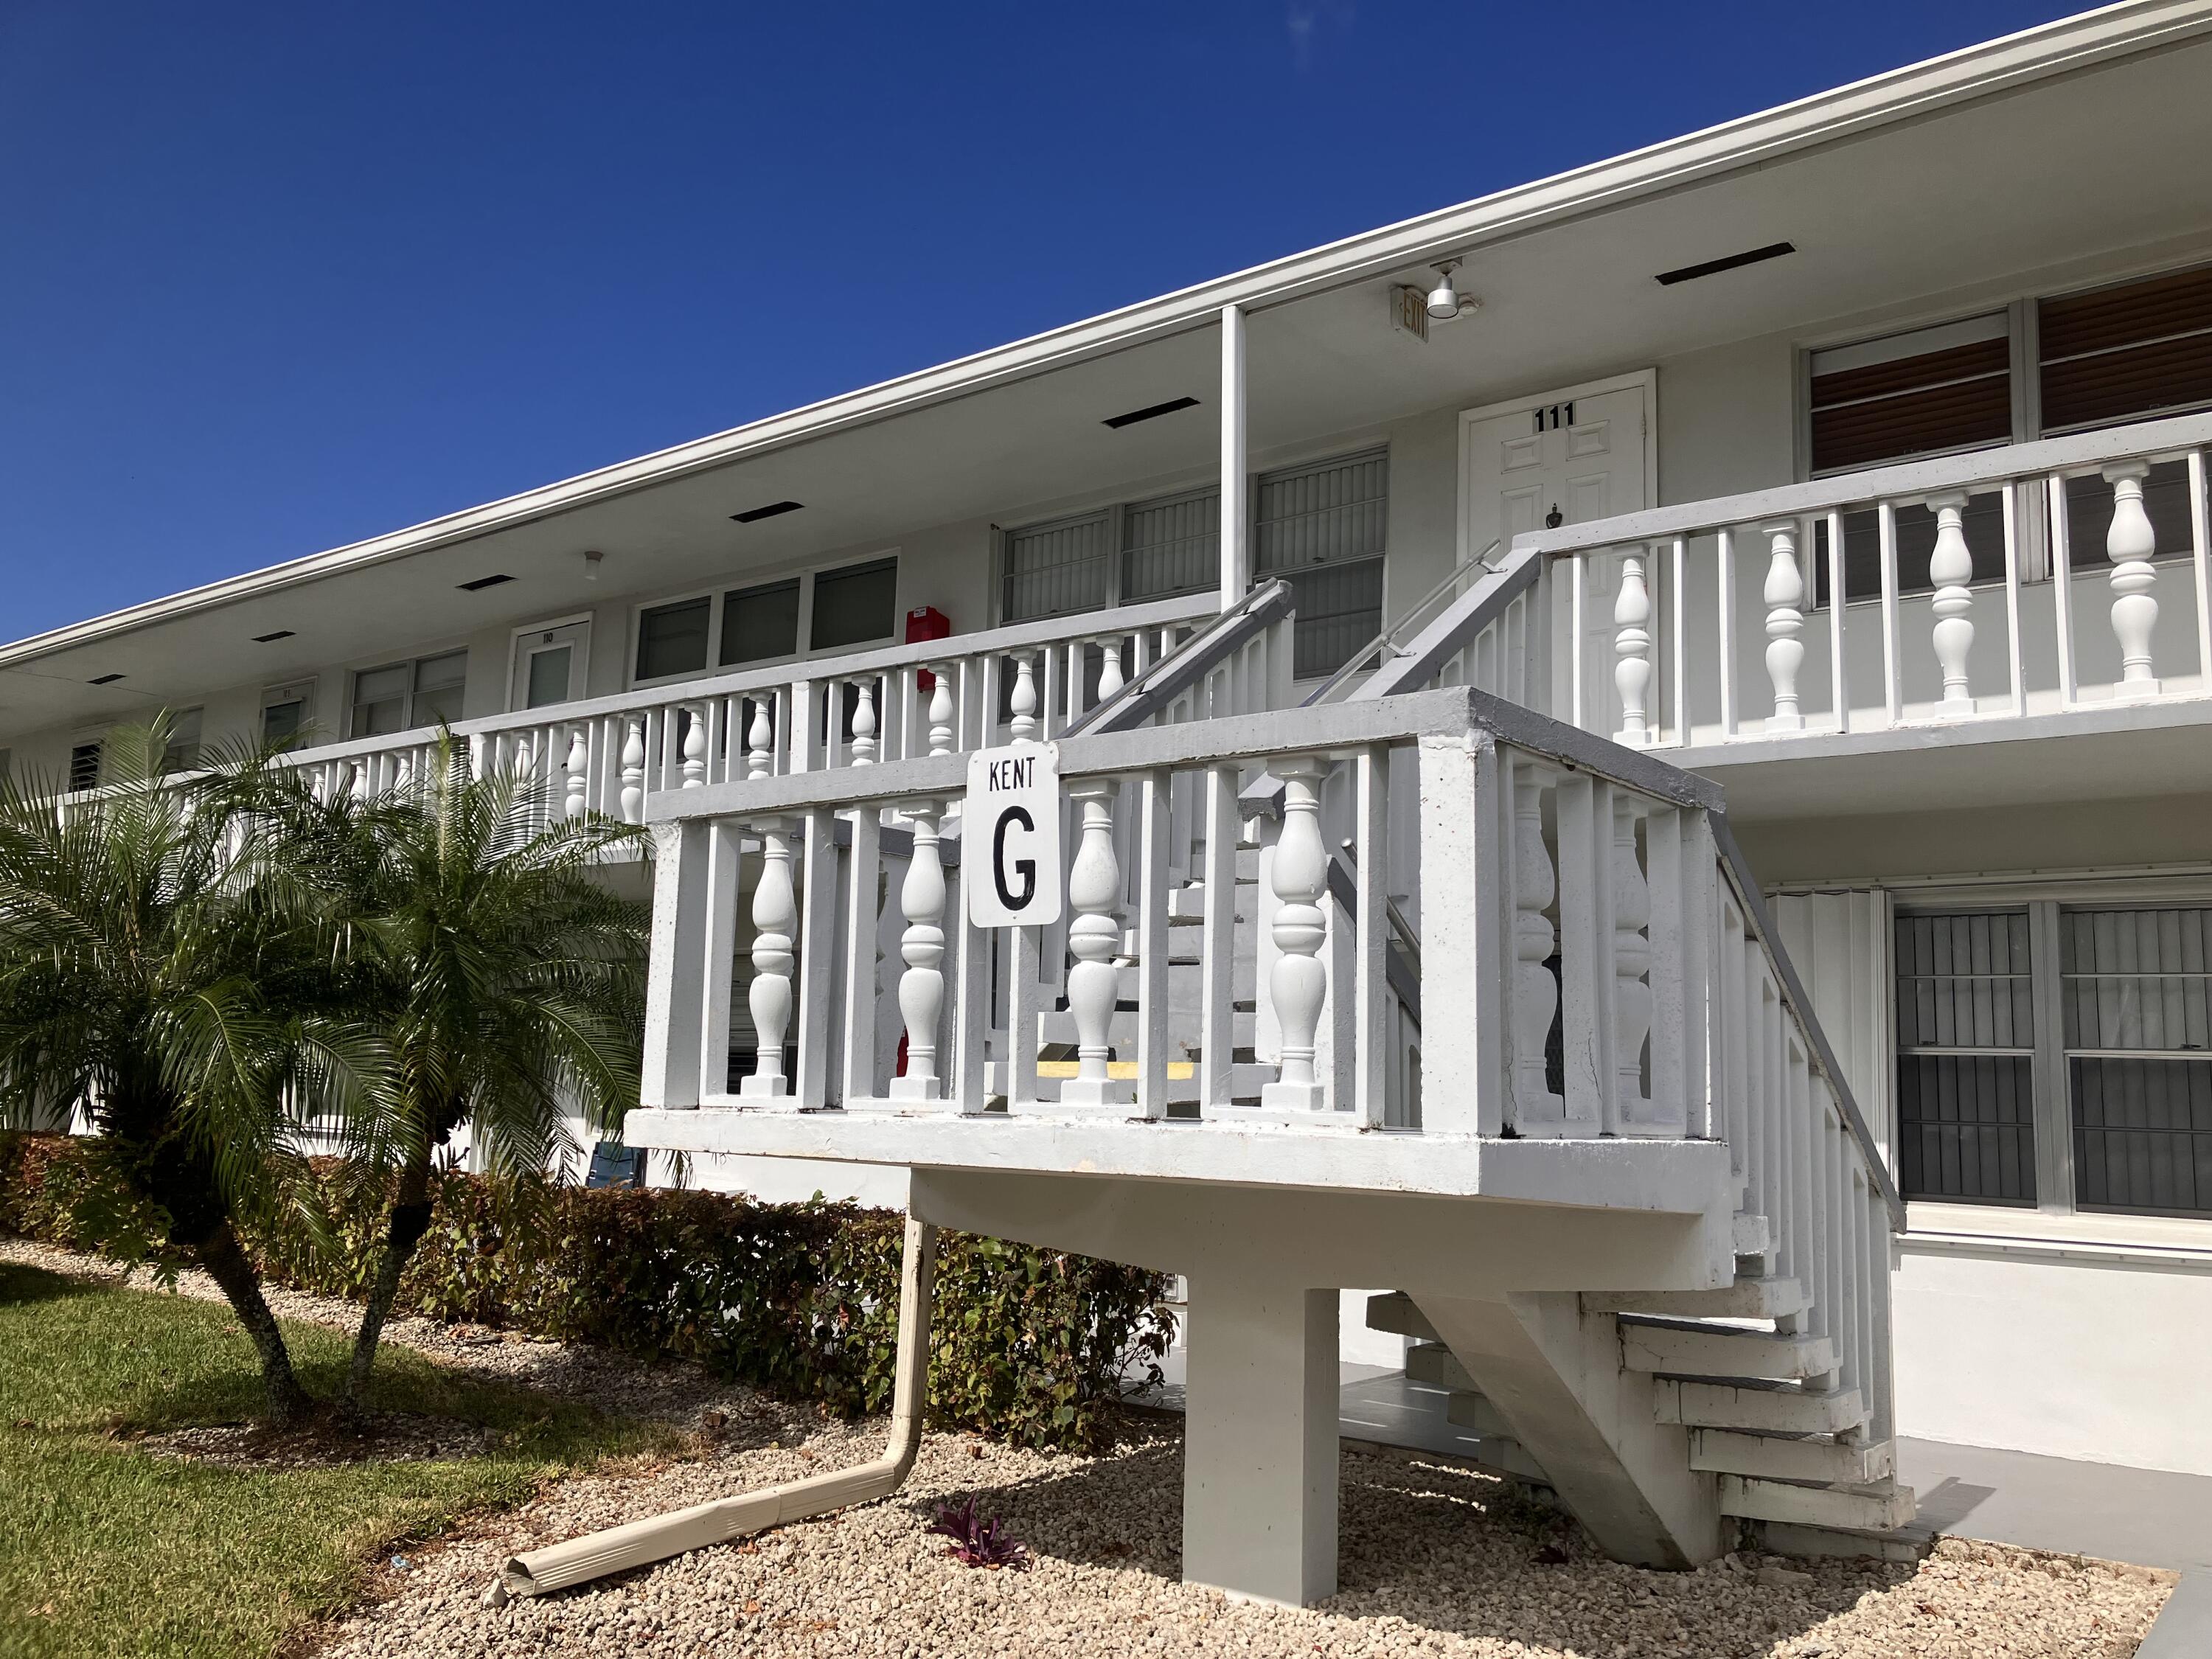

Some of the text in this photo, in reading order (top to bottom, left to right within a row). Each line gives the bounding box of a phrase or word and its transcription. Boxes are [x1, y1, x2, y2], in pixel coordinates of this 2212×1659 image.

[1404, 291, 1426, 338] EXIT
[1535, 402, 1573, 432] 111
[543, 633, 553, 644] 110
[989, 757, 1035, 792] KENT
[993, 805, 1035, 911] G
